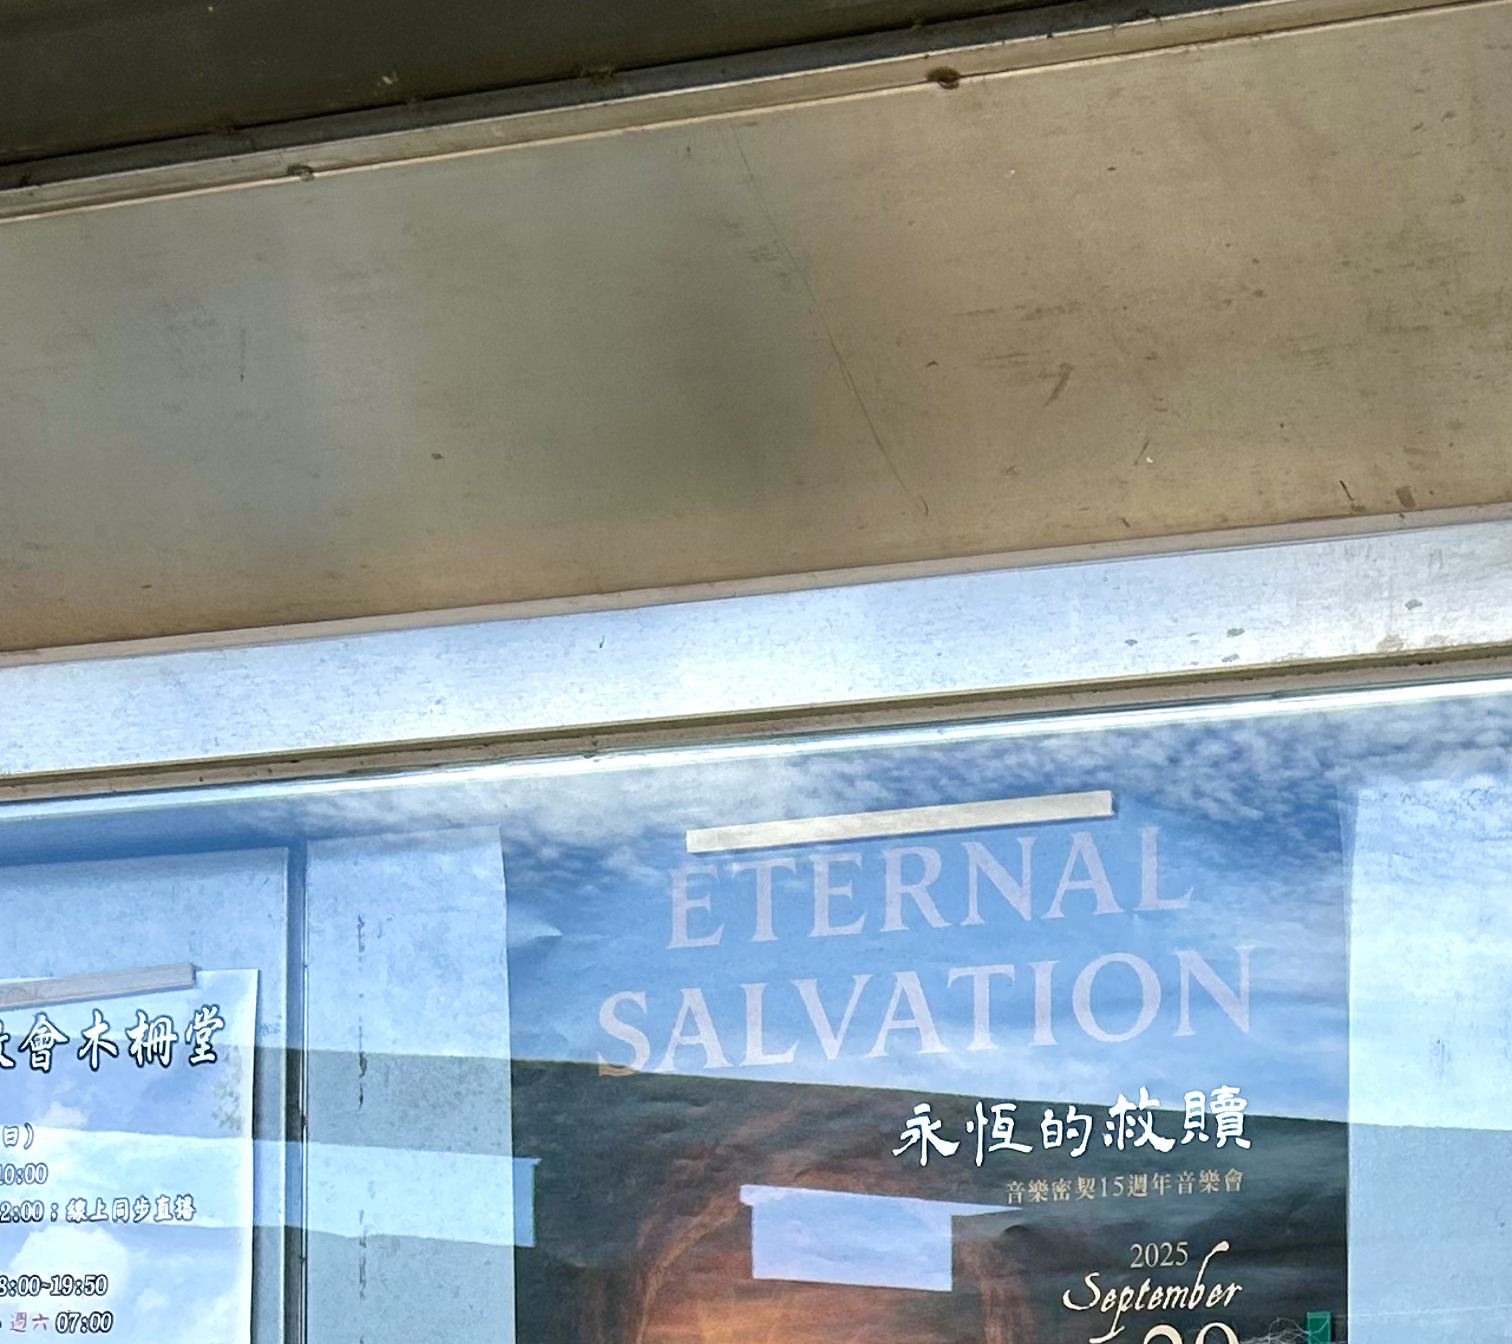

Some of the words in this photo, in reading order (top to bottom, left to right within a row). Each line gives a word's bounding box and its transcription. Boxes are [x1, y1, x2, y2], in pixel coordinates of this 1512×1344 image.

[667, 825, 1194, 951] ETERNAL
[597, 945, 1261, 1076] SALVATION
[1005, 1168, 1244, 1204] 音樂密契15週年音樂會
[1130, 1241, 1188, 1268] 2025
[55, 1311, 113, 1333] 07:00
[1062, 1240, 1243, 1344] September
